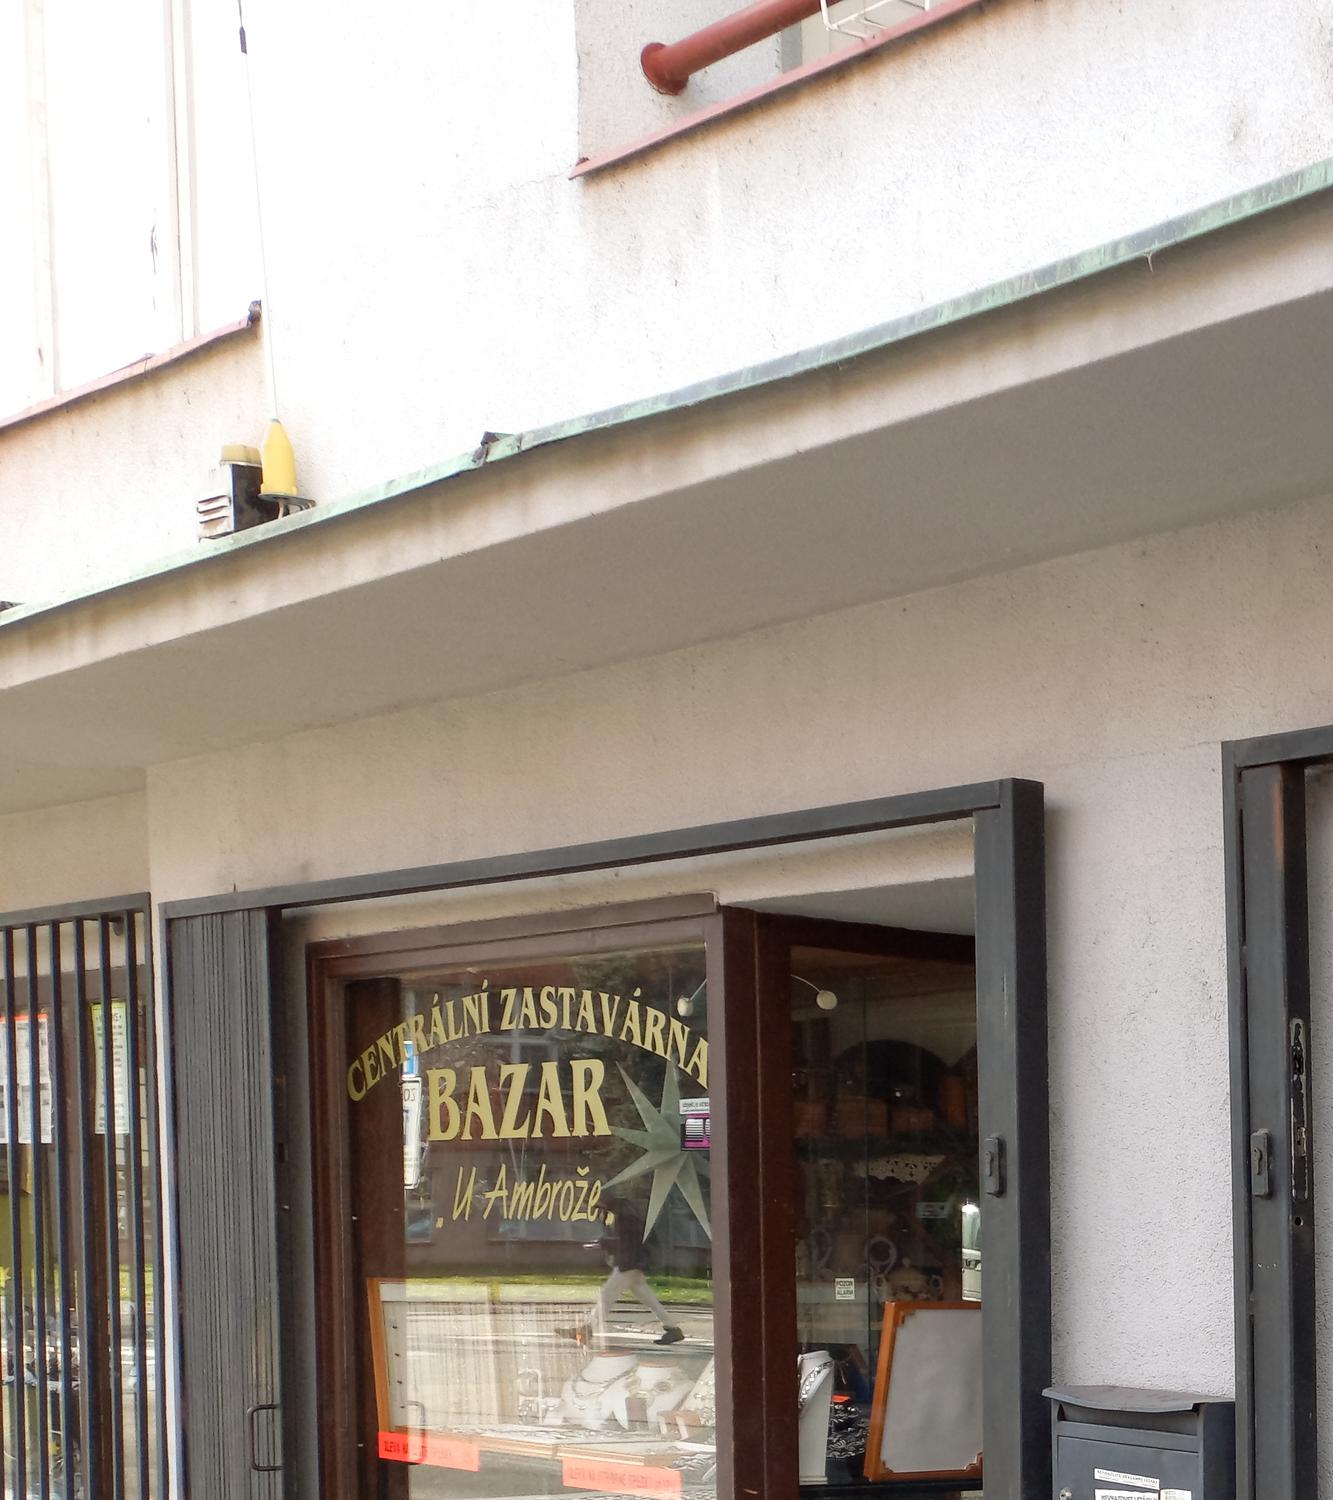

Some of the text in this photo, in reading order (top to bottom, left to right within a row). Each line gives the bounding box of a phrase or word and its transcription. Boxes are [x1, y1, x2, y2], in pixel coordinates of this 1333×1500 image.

[346, 978, 709, 1102] CENTRÁLNÍ ZASTAVÁRNA
[425, 1058, 613, 1142] BAZAR
